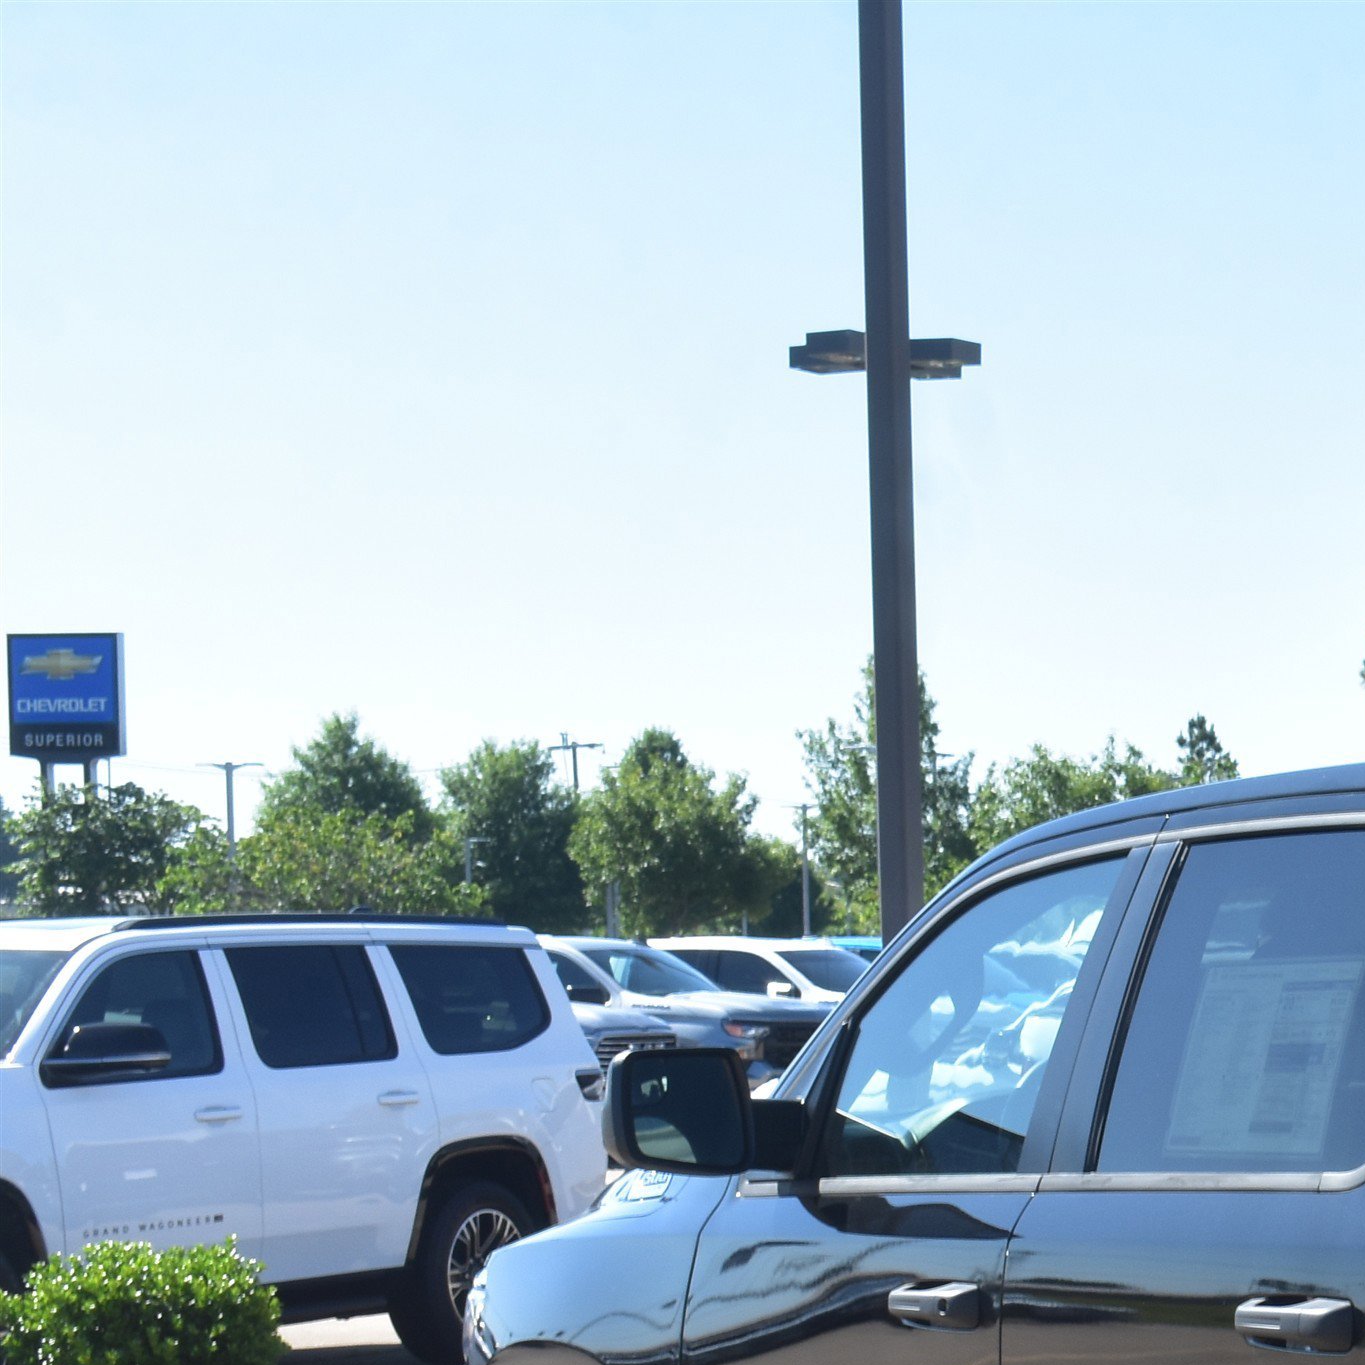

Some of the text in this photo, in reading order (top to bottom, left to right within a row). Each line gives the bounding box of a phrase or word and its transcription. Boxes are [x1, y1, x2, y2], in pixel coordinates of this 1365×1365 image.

[17, 696, 108, 713] CHEVROLET
[25, 733, 104, 747] SUPERIOR
[83, 1215, 211, 1239] GRAND WAGONEER
